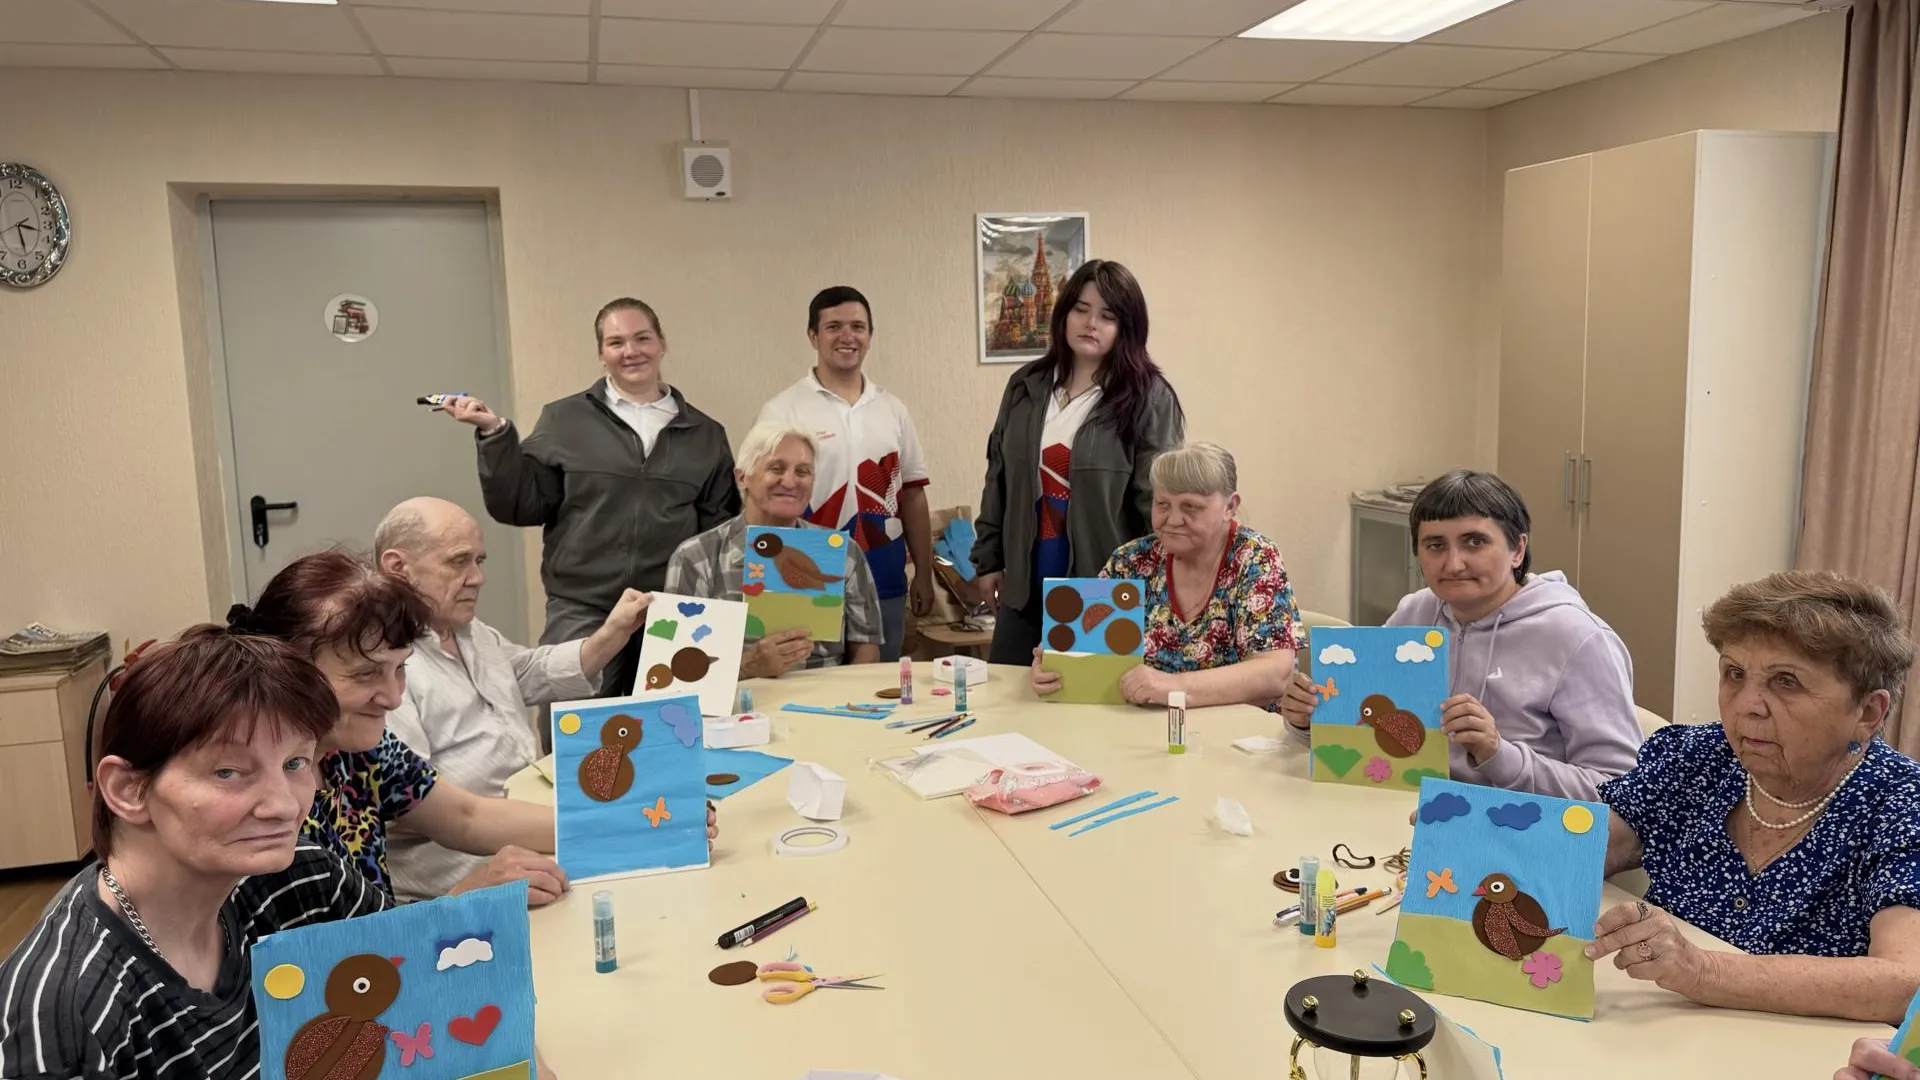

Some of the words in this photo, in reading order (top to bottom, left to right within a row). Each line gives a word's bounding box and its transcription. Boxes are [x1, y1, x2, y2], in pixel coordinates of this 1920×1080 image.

[9, 179, 23, 189] 12
[41, 206, 50, 216] 2
[43, 220, 53, 230] 3
[35, 251, 44, 260] 5
[17, 260, 27, 269] 6
